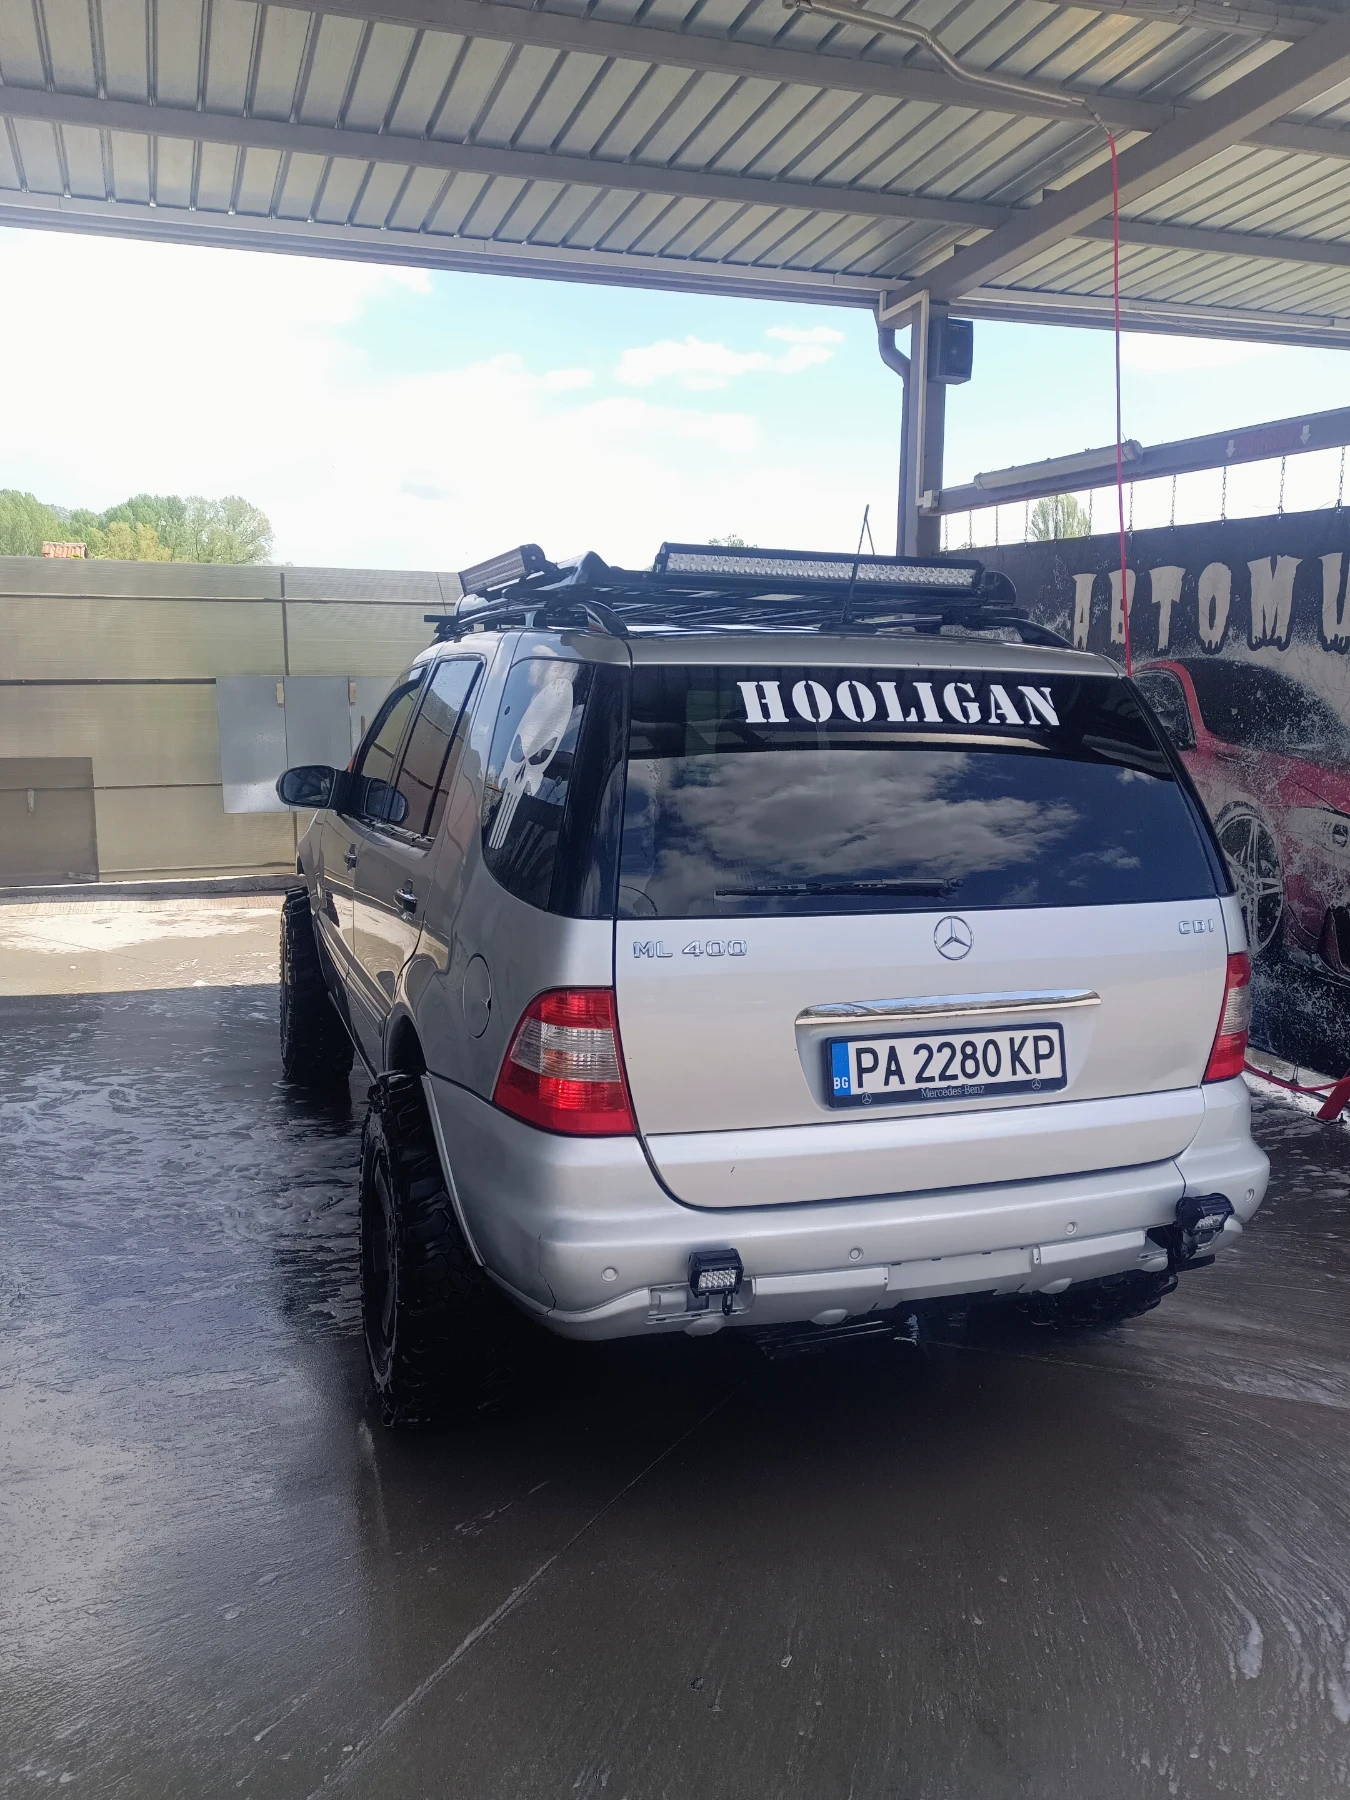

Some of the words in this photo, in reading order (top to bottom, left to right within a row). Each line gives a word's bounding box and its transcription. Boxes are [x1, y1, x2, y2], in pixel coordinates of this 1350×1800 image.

[737, 680, 1060, 726] HOOLIGAN
[1179, 919, 1214, 934] CDI
[633, 941, 673, 958] ML
[682, 940, 747, 957] 400
[833, 1077, 849, 1090] BG
[921, 1085, 985, 1099] Mercedes-Benz
